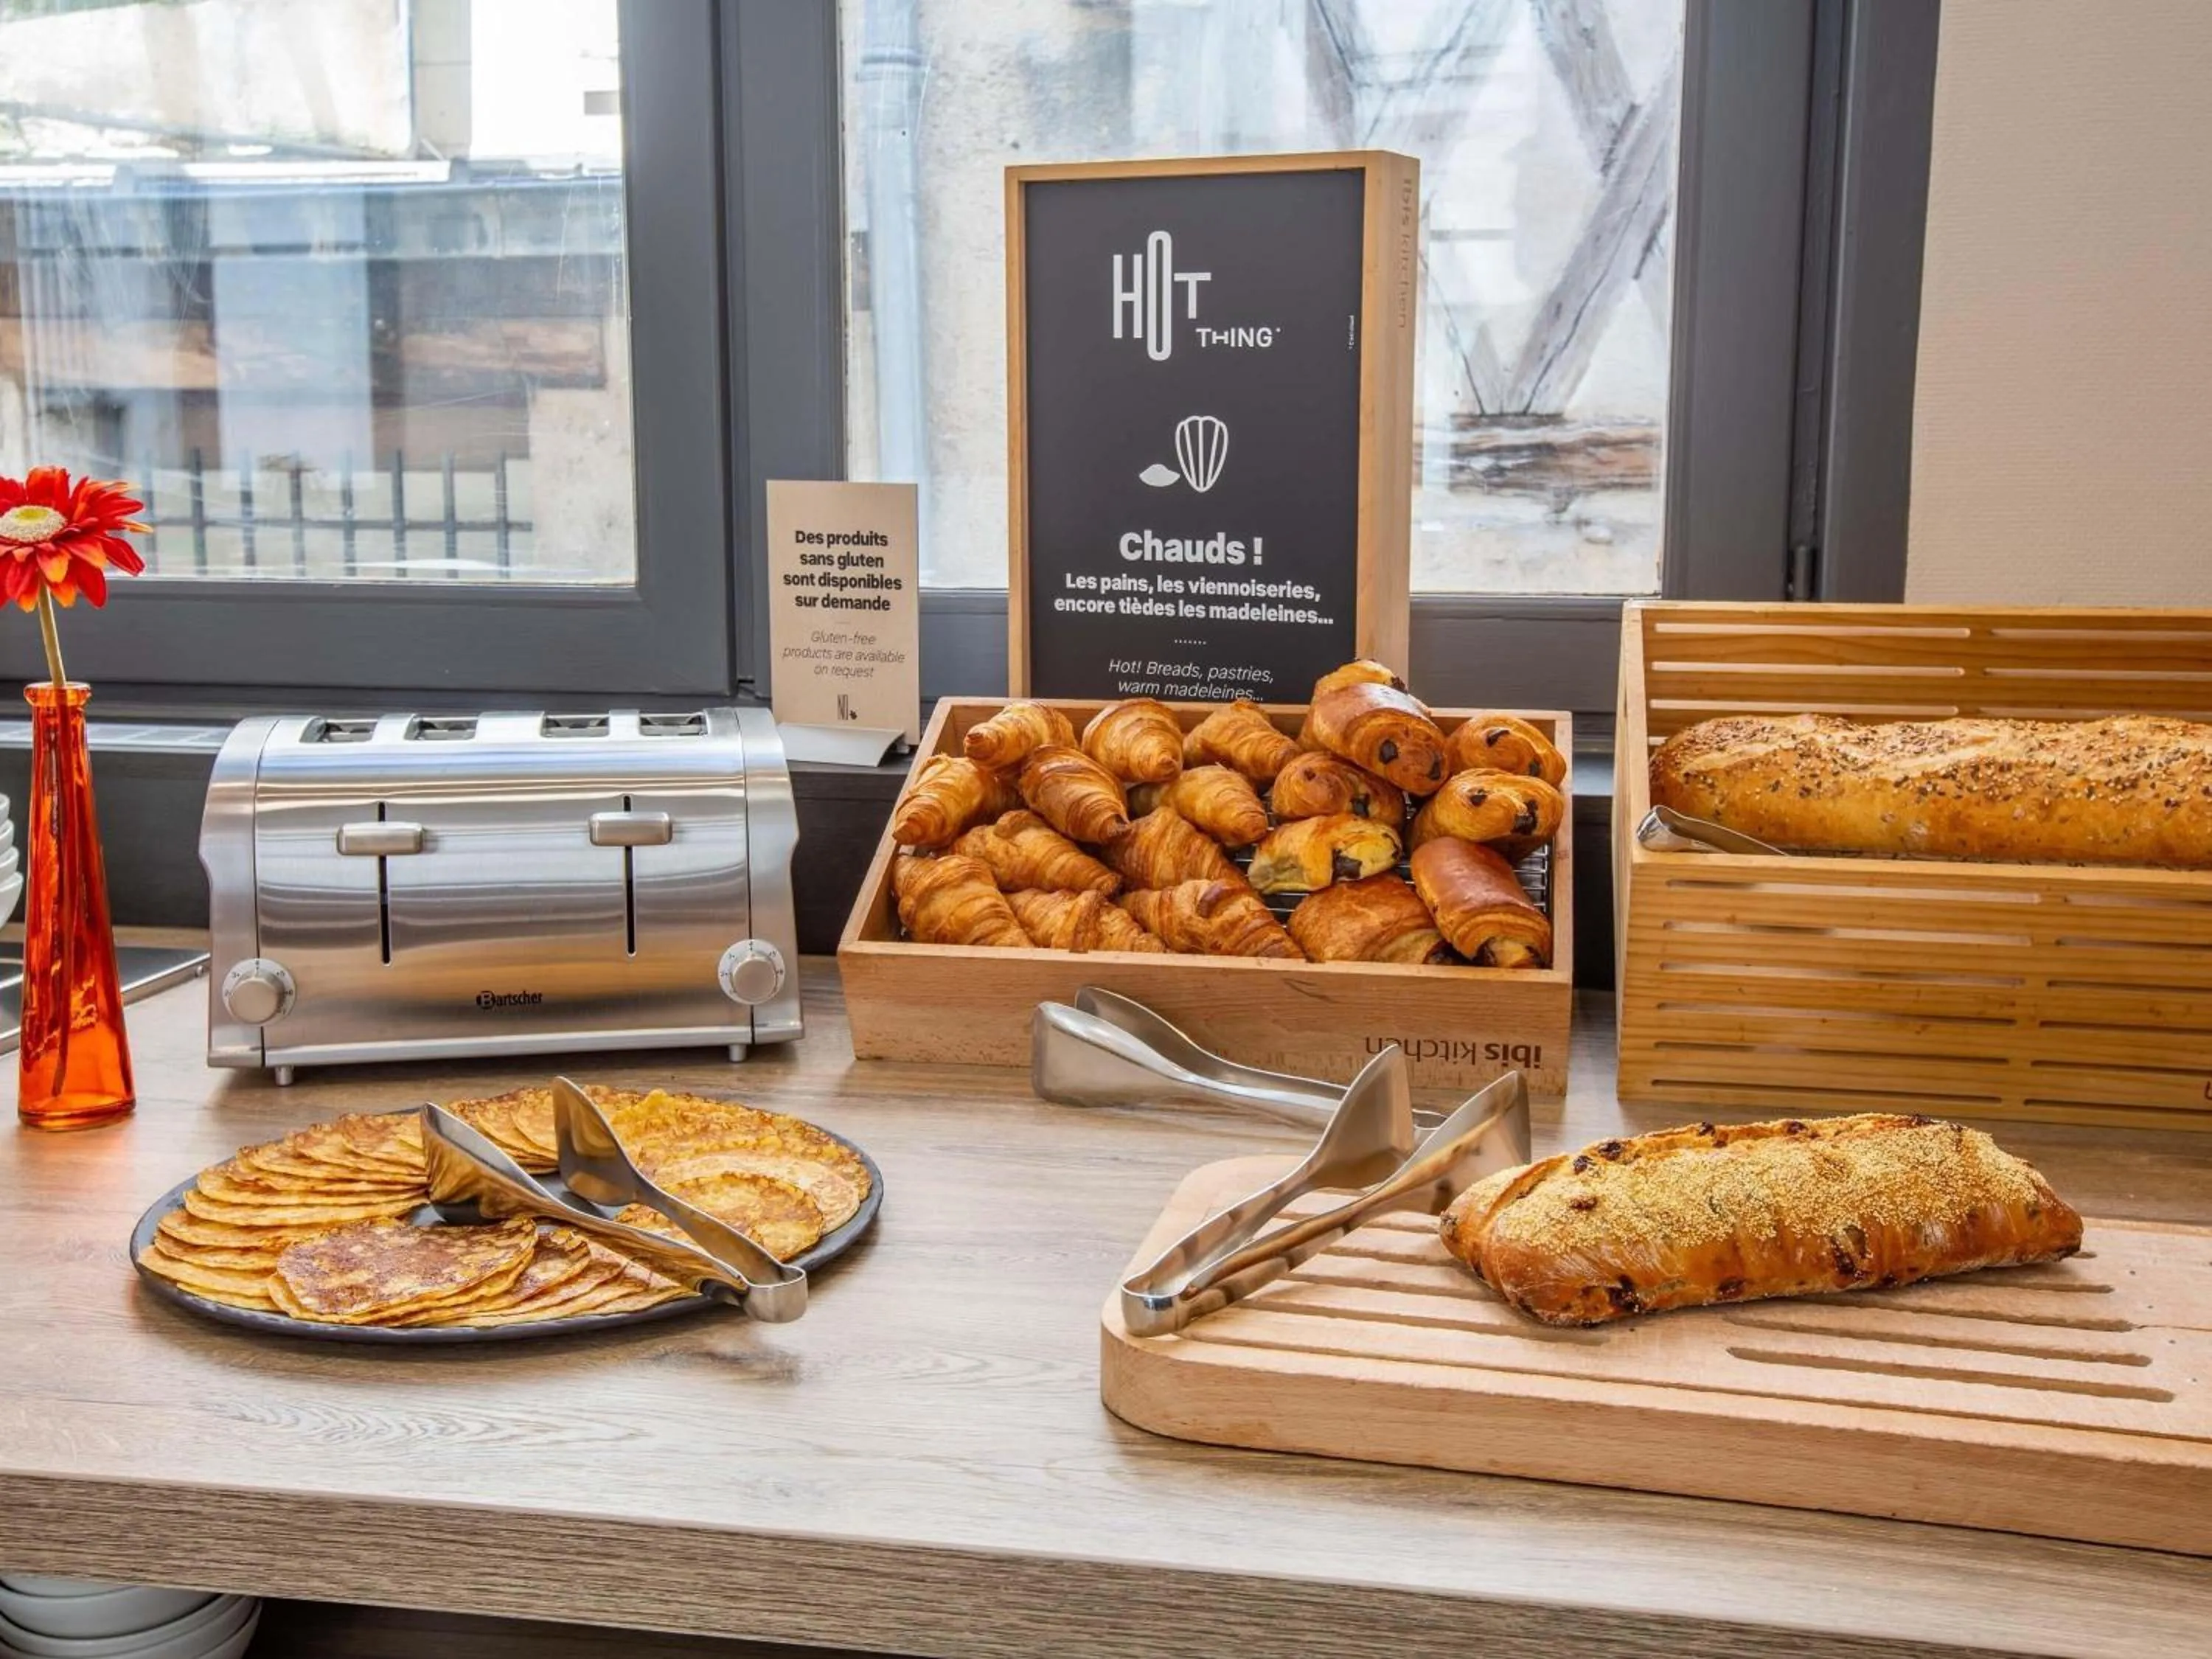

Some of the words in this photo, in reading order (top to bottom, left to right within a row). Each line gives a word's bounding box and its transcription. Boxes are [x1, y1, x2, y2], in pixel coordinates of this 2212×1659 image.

[1113, 230, 1211, 361] HOT
[795, 530, 824, 544] Des
[827, 531, 888, 548] produits
[1119, 529, 1245, 566] Chauds
[1253, 537, 1263, 566] !
[799, 553, 834, 566] sans
[838, 552, 884, 569] gluten
[783, 573, 815, 585] sont
[818, 572, 902, 591] disponibles
[1065, 573, 1097, 590] Les
[1101, 573, 1154, 595] pains,
[1157, 575, 1184, 594] les
[1188, 577, 1321, 602] viennoiseries,
[795, 594, 818, 608] sur
[821, 594, 891, 611] demande
[1054, 597, 1116, 613] encore
[1119, 597, 1176, 617] tièdes
[1179, 599, 1206, 618] les
[1209, 602, 1334, 625] madeleines...
[811, 630, 877, 645] Gluten-free
[782, 647, 832, 660] products
[834, 649, 853, 661] are
[855, 649, 905, 663] available
[814, 665, 828, 675] on
[831, 665, 874, 679] request
[1108, 659, 1141, 675] Hot!
[1147, 661, 1203, 679] Breads,
[1207, 665, 1274, 684] pastries,
[1118, 680, 1160, 695] warm
[476, 990, 543, 1009] Bartscher
[1484, 1043, 1543, 1069] ibis
